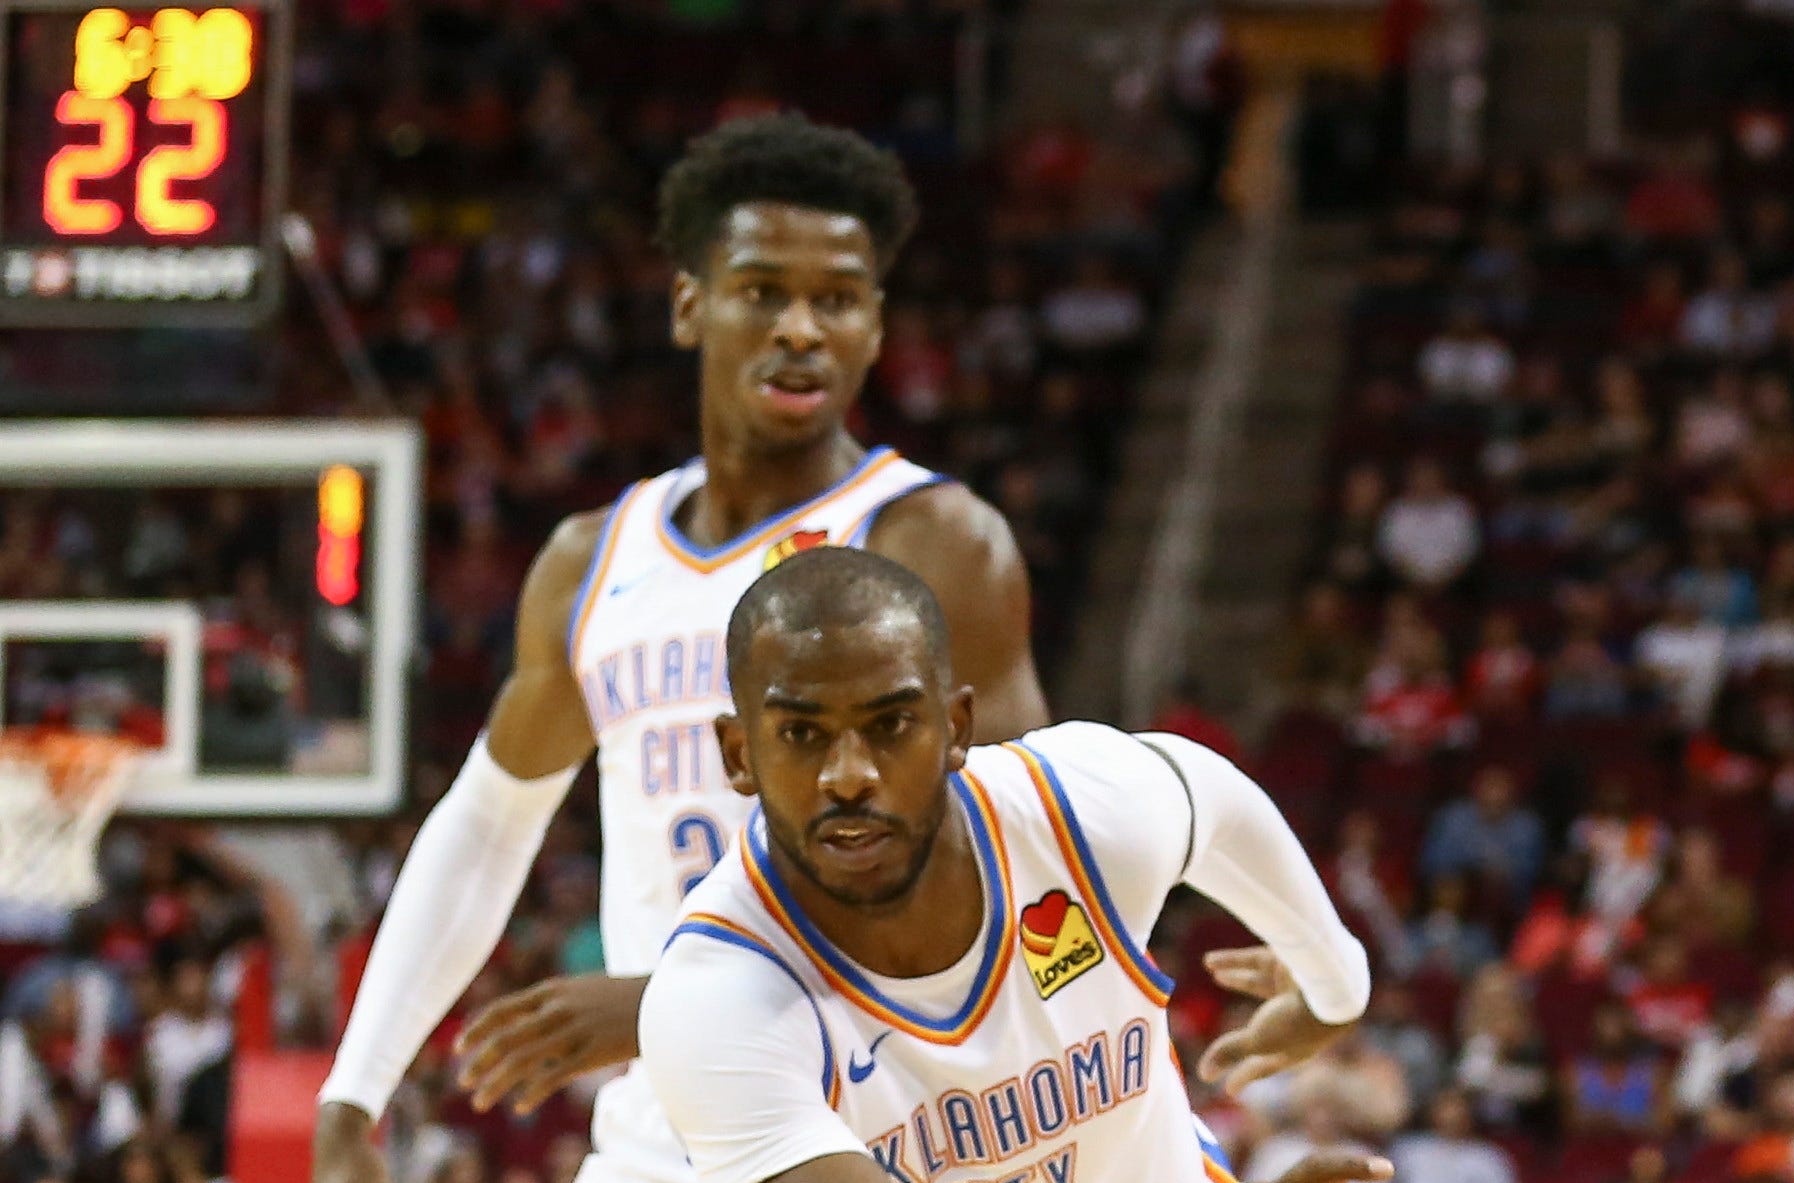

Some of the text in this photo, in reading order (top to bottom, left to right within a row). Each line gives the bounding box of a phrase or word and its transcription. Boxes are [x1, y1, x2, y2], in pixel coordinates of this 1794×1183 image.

[43, 90, 228, 235] 22
[579, 630, 734, 738] KLAH
[639, 717, 712, 796] CIT
